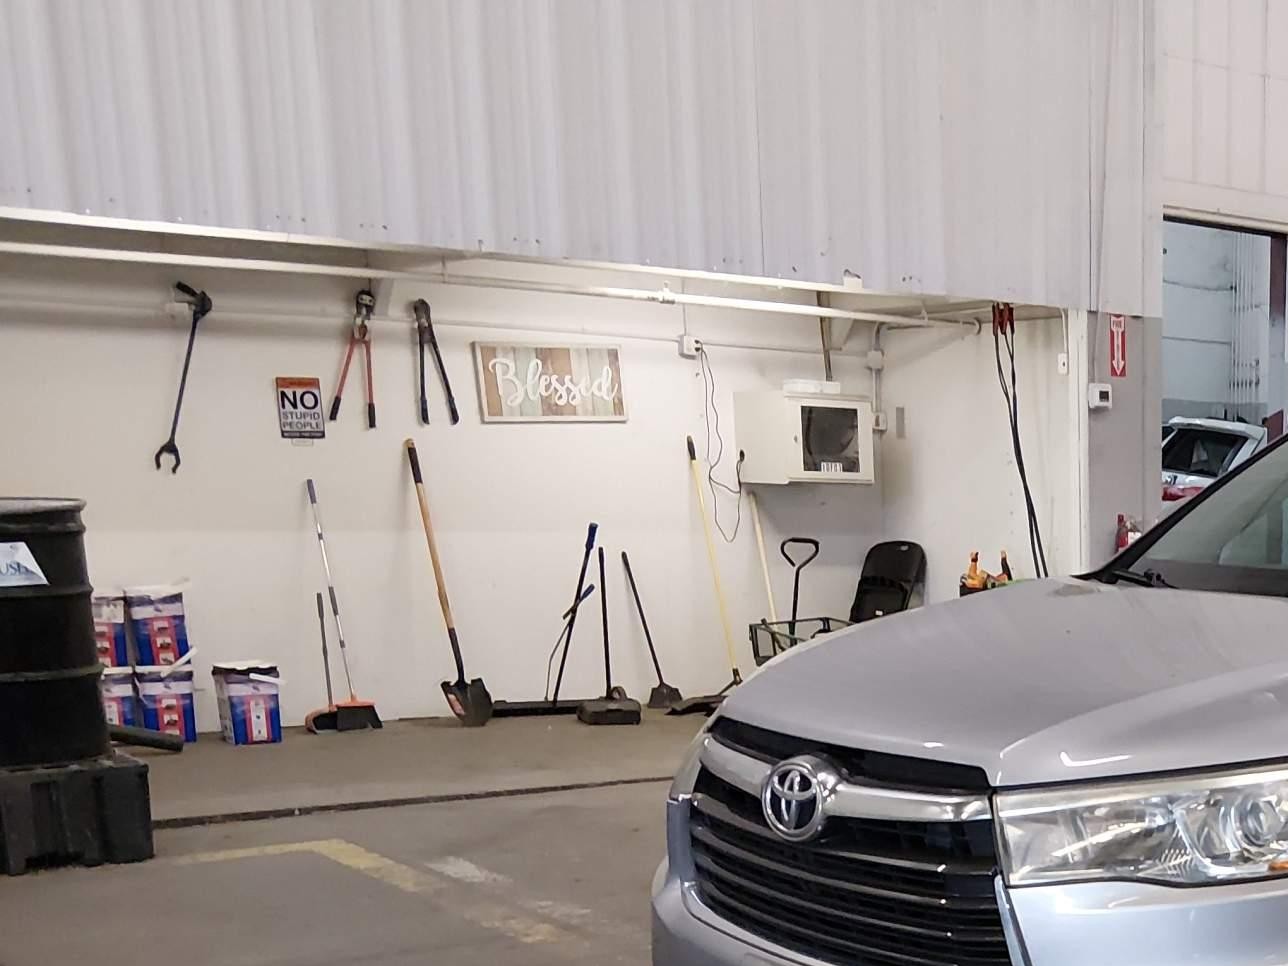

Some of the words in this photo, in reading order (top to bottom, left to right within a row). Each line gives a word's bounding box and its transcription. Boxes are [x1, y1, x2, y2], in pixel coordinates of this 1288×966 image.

[488, 358, 618, 407] Blessed
[280, 390, 319, 410] NO
[282, 411, 321, 421] STUPID
[283, 421, 321, 430] PEOPLE
